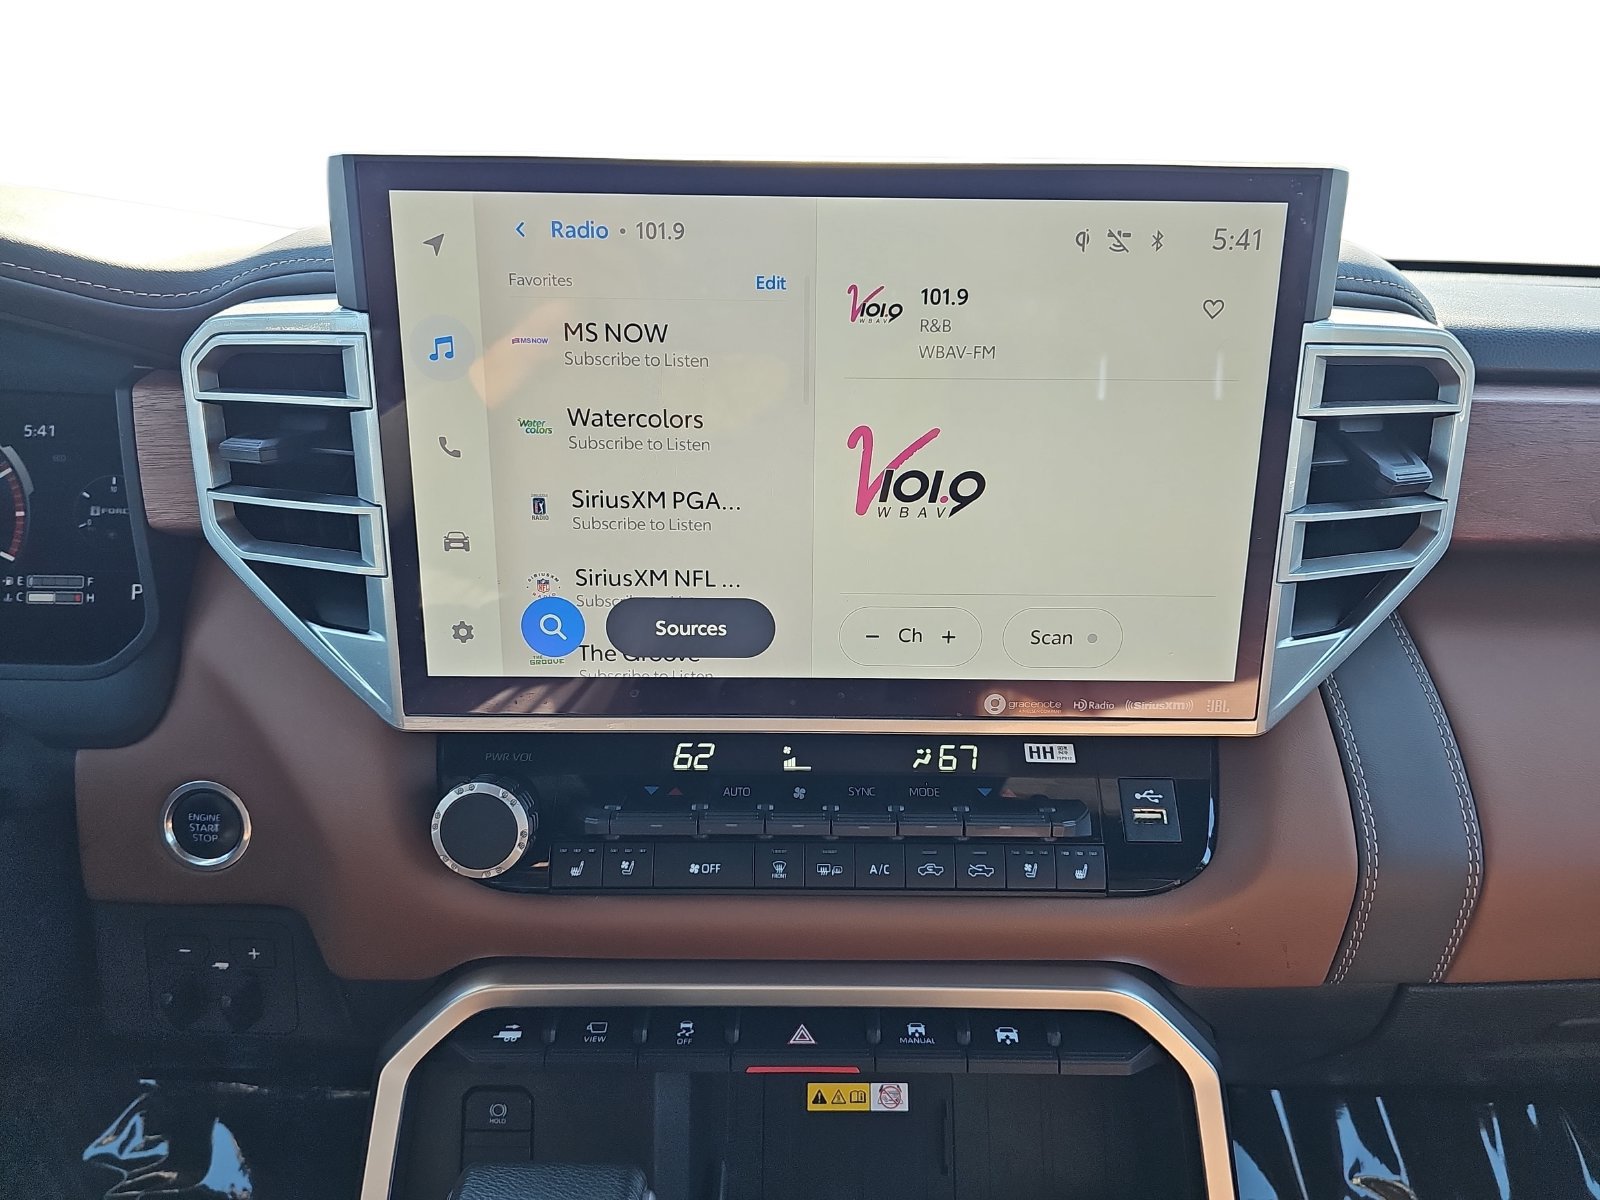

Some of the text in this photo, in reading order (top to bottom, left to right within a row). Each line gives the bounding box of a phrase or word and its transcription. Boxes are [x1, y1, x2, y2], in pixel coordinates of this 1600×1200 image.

[551, 220, 685, 241] Radio 101.9
[1211, 228, 1263, 251] 5:41
[508, 272, 573, 288] Favorites
[756, 275, 787, 291] Edit
[920, 288, 969, 306] 101.9
[564, 322, 669, 343] MS NOW
[920, 318, 952, 333] R&B
[564, 351, 710, 368] Subscribe to Listen
[919, 345, 996, 360] WBAV-FM
[518, 419, 546, 428] Water
[567, 407, 704, 429] Watercolors
[23, 424, 56, 438] 5:41
[525, 427, 553, 435] colors
[568, 435, 711, 452] Subscribe to Listen
[571, 489, 666, 509] SiriusXM
[876, 506, 946, 519] WBAV
[572, 516, 713, 533] Subscribe to Listen
[17, 576, 24, 586] E
[87, 577, 95, 587] F
[575, 568, 668, 587] SiriusXM
[675, 570, 717, 588] NFL
[16, 591, 24, 601] C
[86, 593, 95, 602] H
[131, 583, 143, 600] P
[655, 619, 728, 637] Sources
[898, 627, 924, 644] Ch
[1029, 629, 1074, 646] Scan
[579, 644, 617, 662] The
[1008, 699, 1062, 710] gracenote
[1088, 701, 1115, 710] Radio
[1210, 700, 1230, 713] JBL
[485, 752, 534, 762] PWR VOL
[672, 742, 716, 771] 62
[937, 743, 979, 772] 67
[1028, 745, 1055, 760] HH
[723, 786, 751, 797] AUTO
[848, 786, 876, 797] SYNC
[909, 786, 940, 798] MODE
[188, 812, 221, 822] ENGINE
[189, 823, 219, 833] START
[192, 833, 218, 843] STOP
[701, 862, 721, 874] OFF
[869, 864, 890, 875] A/C
[583, 1035, 607, 1043] VIEW
[676, 1037, 693, 1045] OFF
[899, 1036, 935, 1045] MANUAL
